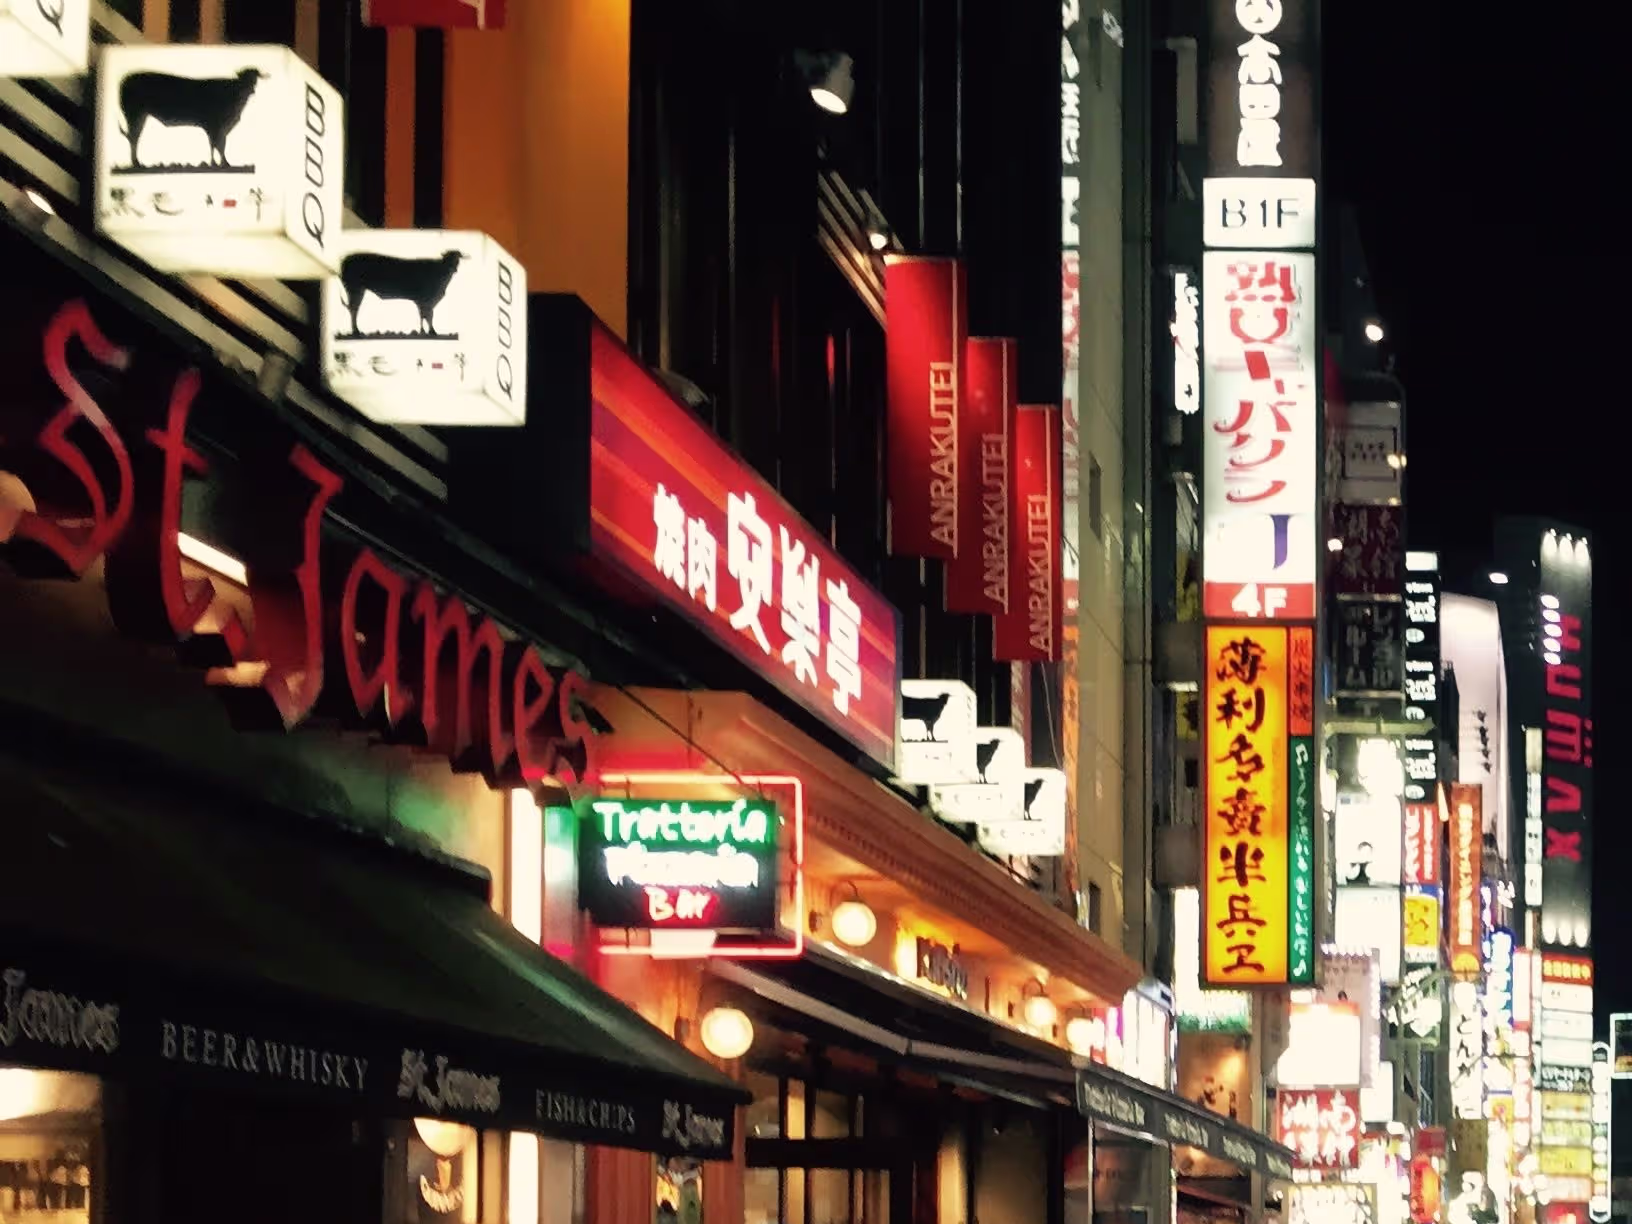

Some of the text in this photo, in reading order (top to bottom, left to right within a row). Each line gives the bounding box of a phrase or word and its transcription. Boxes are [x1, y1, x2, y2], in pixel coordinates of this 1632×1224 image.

[1220, 199, 1301, 229] B1F
[930, 361, 954, 548] ANRAKUTEI
[982, 432, 1005, 606] ANRAKUTEI
[1027, 494, 1049, 652] ANRAKUTEI
[1230, 584, 1289, 617] 4F
[268, 445, 594, 785] James
[593, 798, 768, 843] Trattoria
[643, 886, 711, 922] Bar
[160, 1019, 370, 1094] BEER&WHISKY
[535, 1088, 637, 1135] FISH&CHIPS
